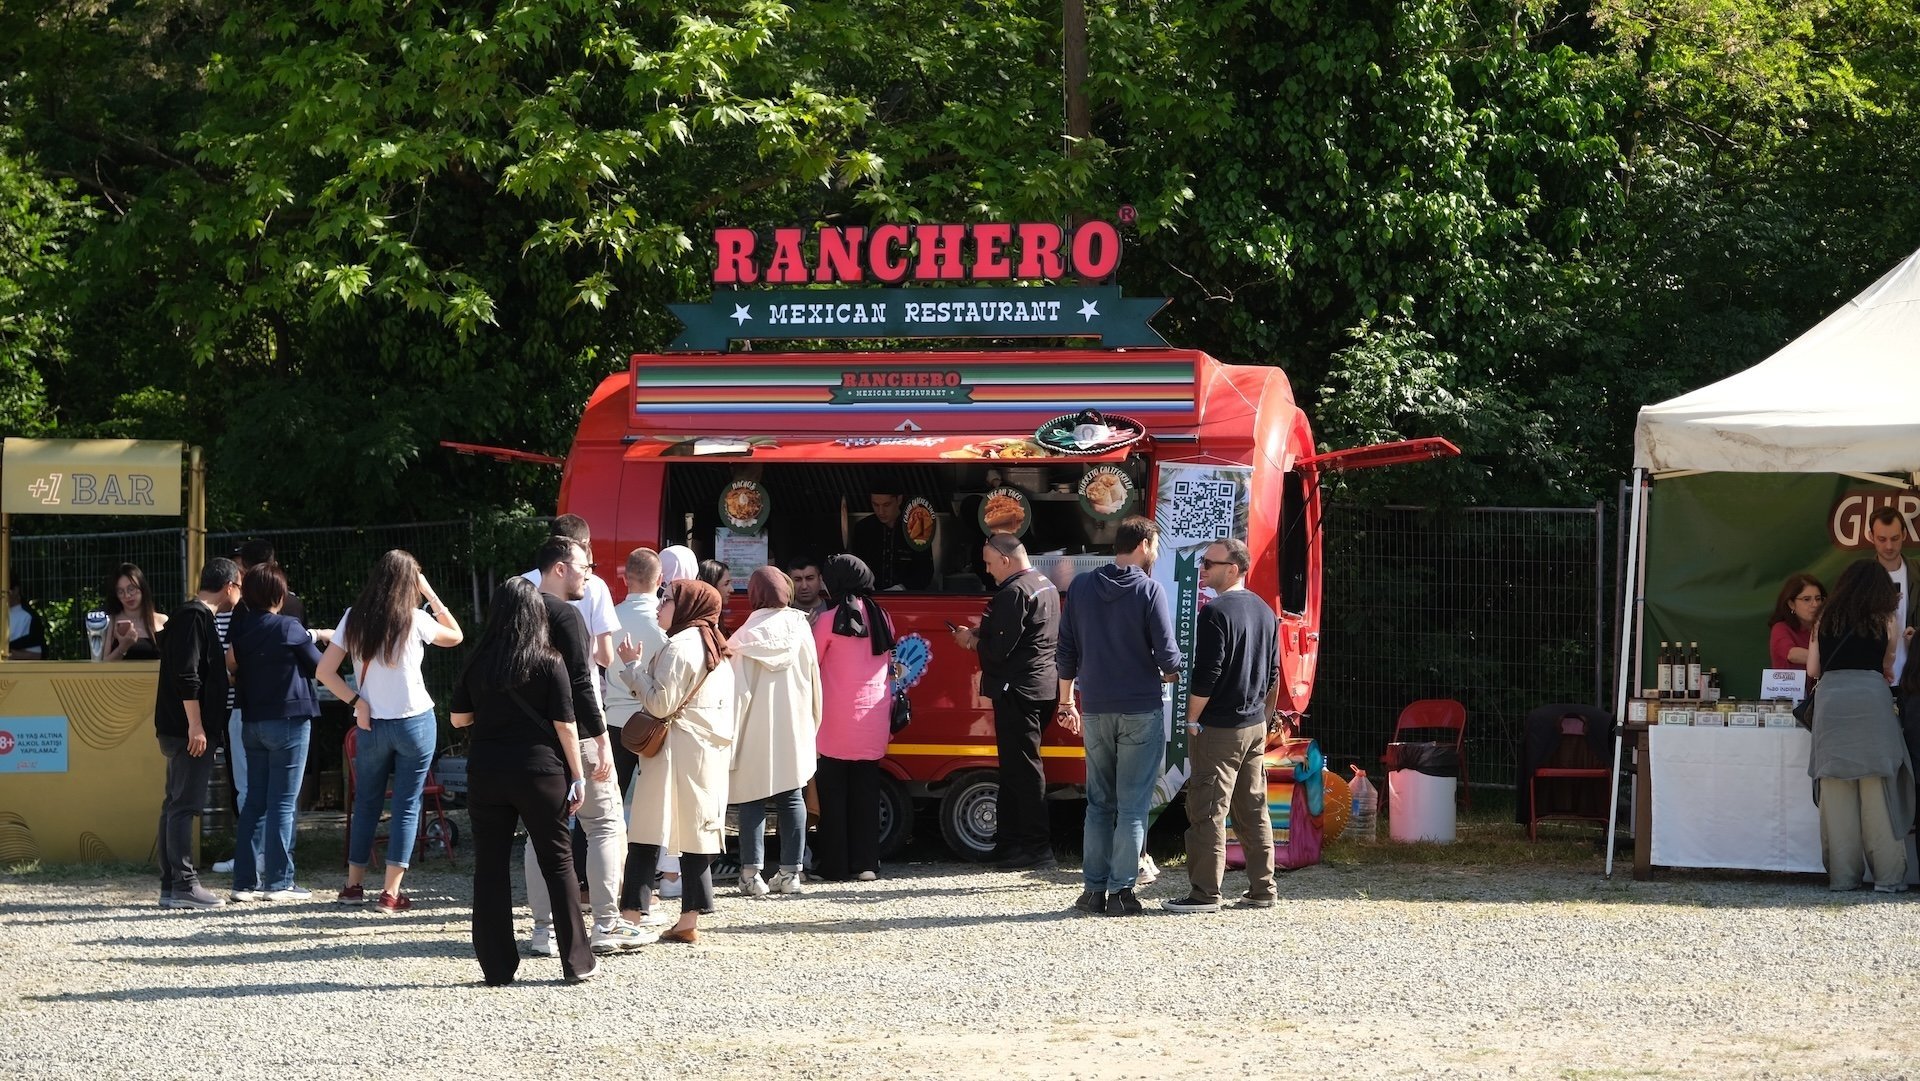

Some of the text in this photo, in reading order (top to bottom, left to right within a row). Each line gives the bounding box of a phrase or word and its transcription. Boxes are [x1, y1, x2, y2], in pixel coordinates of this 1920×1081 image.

[714, 221, 1122, 284] RANCHERO
[768, 300, 1061, 325] MEXICAN RESTAURANT
[842, 372, 960, 387] RANCHERO
[895, 389, 946, 397] RESTAURANT
[27, 472, 155, 506] +1 BAR
[731, 480, 757, 491] NACHOS
[1078, 465, 1134, 496] BURRITO CALIFORNIA
[986, 488, 1024, 501] VEGAN TACO
[1175, 589, 1193, 735] MEXICAN RESTAURANT
